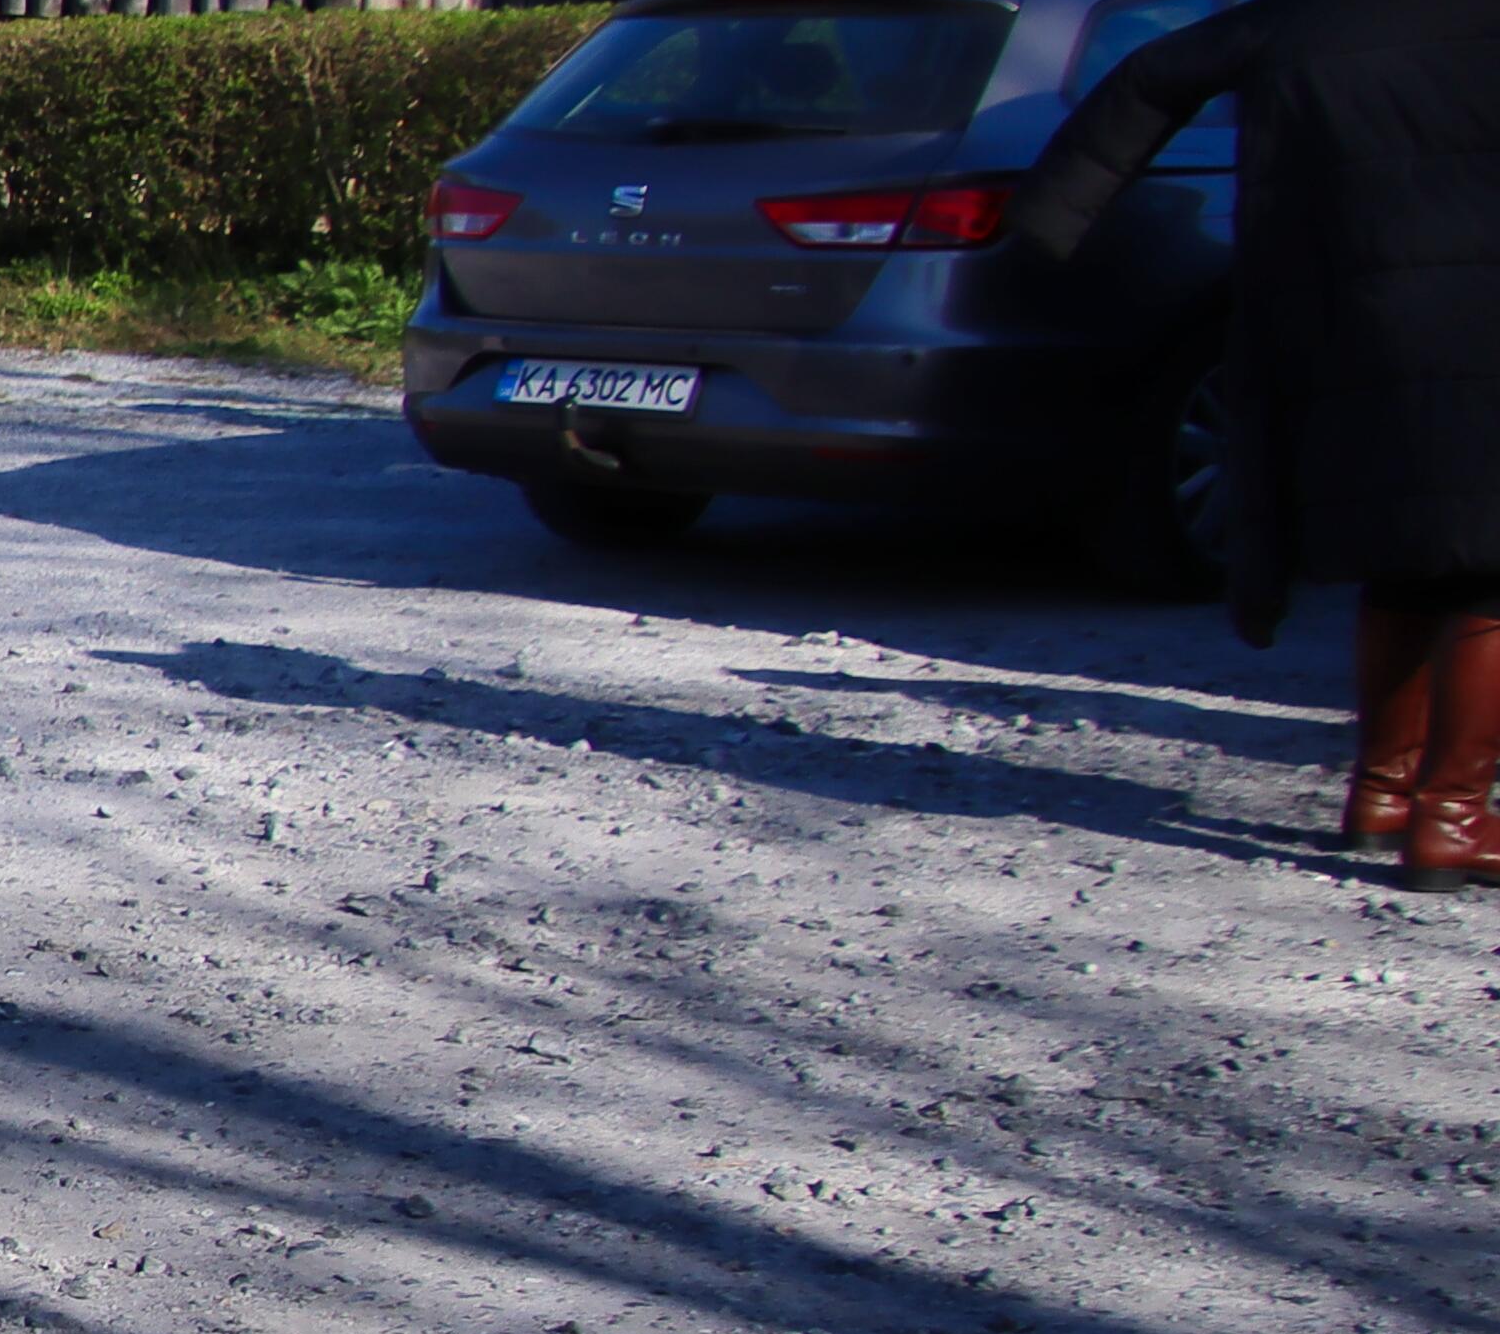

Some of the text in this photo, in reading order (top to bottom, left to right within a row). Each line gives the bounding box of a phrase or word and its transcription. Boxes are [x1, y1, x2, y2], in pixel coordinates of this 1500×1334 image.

[570, 230, 682, 246] LEON
[514, 366, 688, 405] KA 6302 MC
